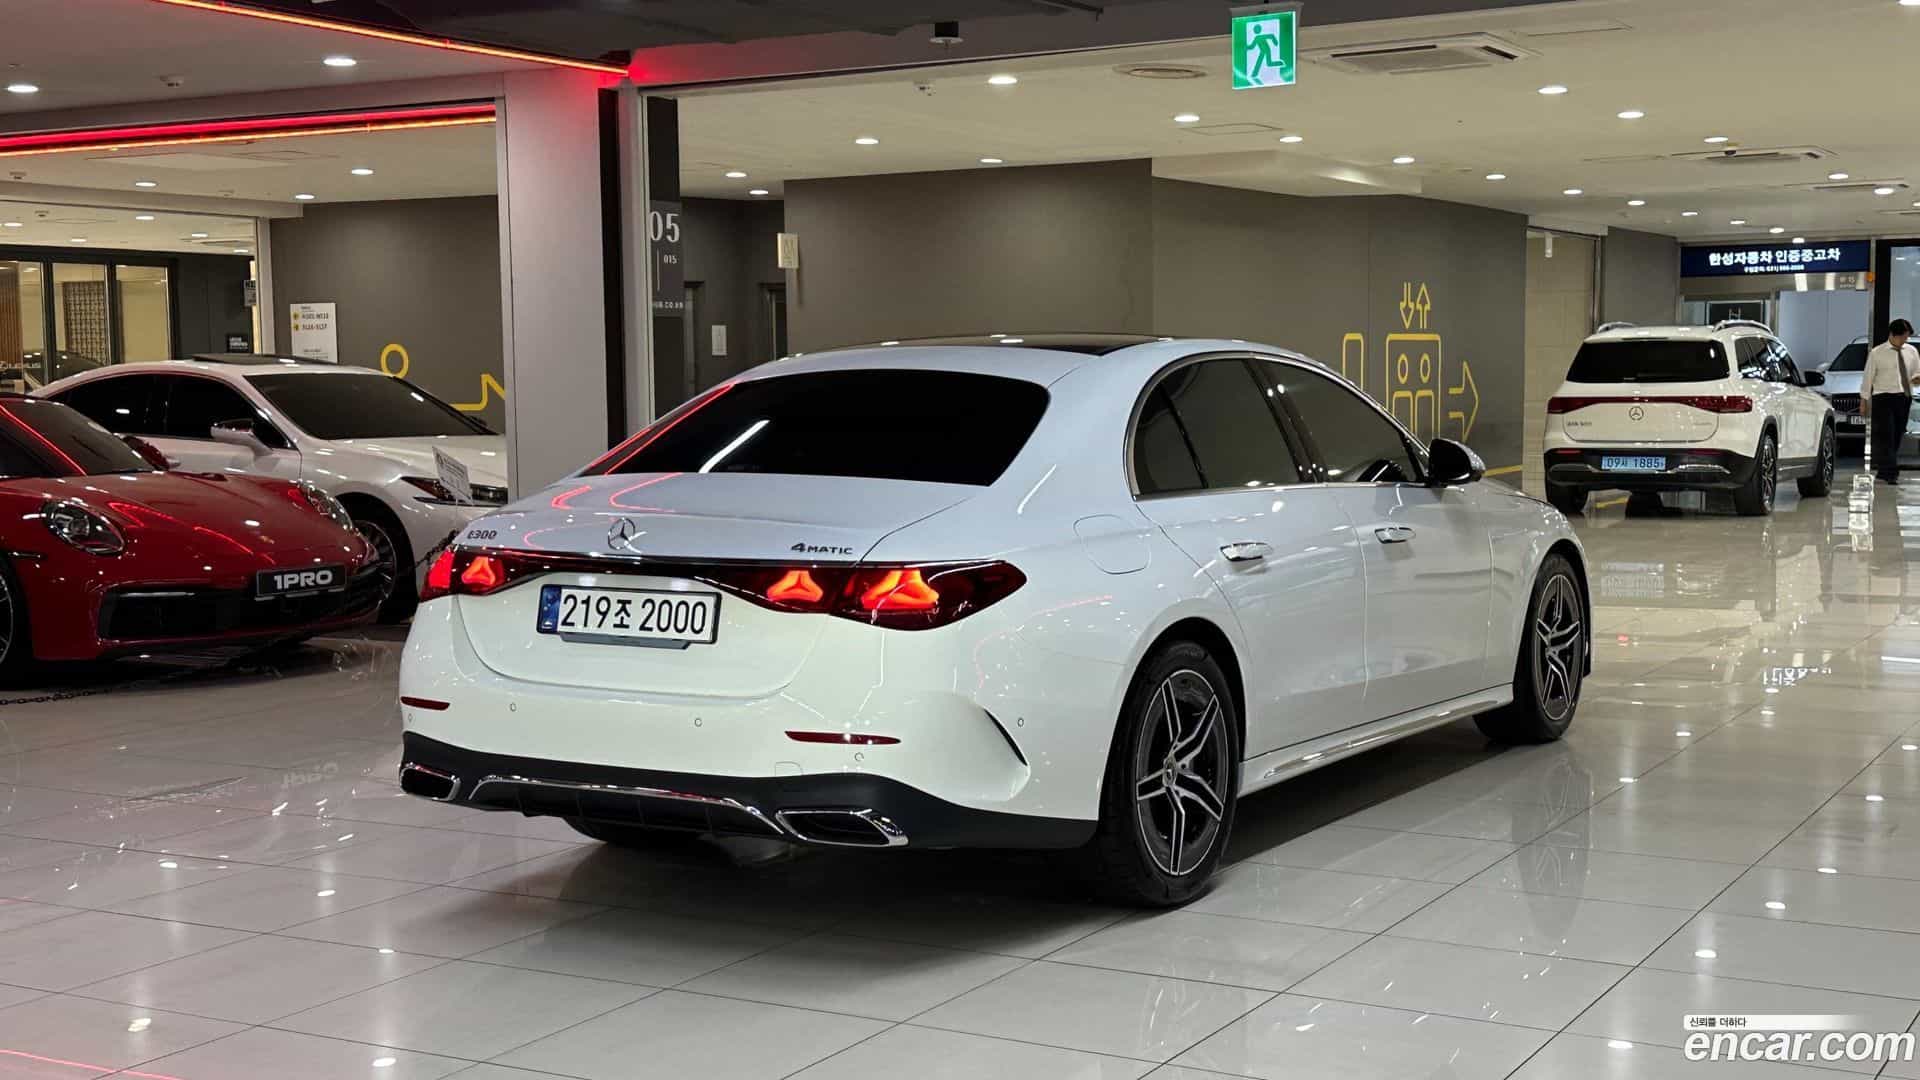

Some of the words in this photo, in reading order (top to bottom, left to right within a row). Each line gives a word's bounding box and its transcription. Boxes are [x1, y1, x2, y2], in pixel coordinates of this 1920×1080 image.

[1709, 251, 1772, 266] 한성자동차
[1775, 248, 1841, 263] 인증중고차
[791, 542, 853, 555] 4MATIC
[273, 569, 333, 590] 1PRO
[561, 594, 632, 629] 219조
[639, 598, 707, 635] 2000
